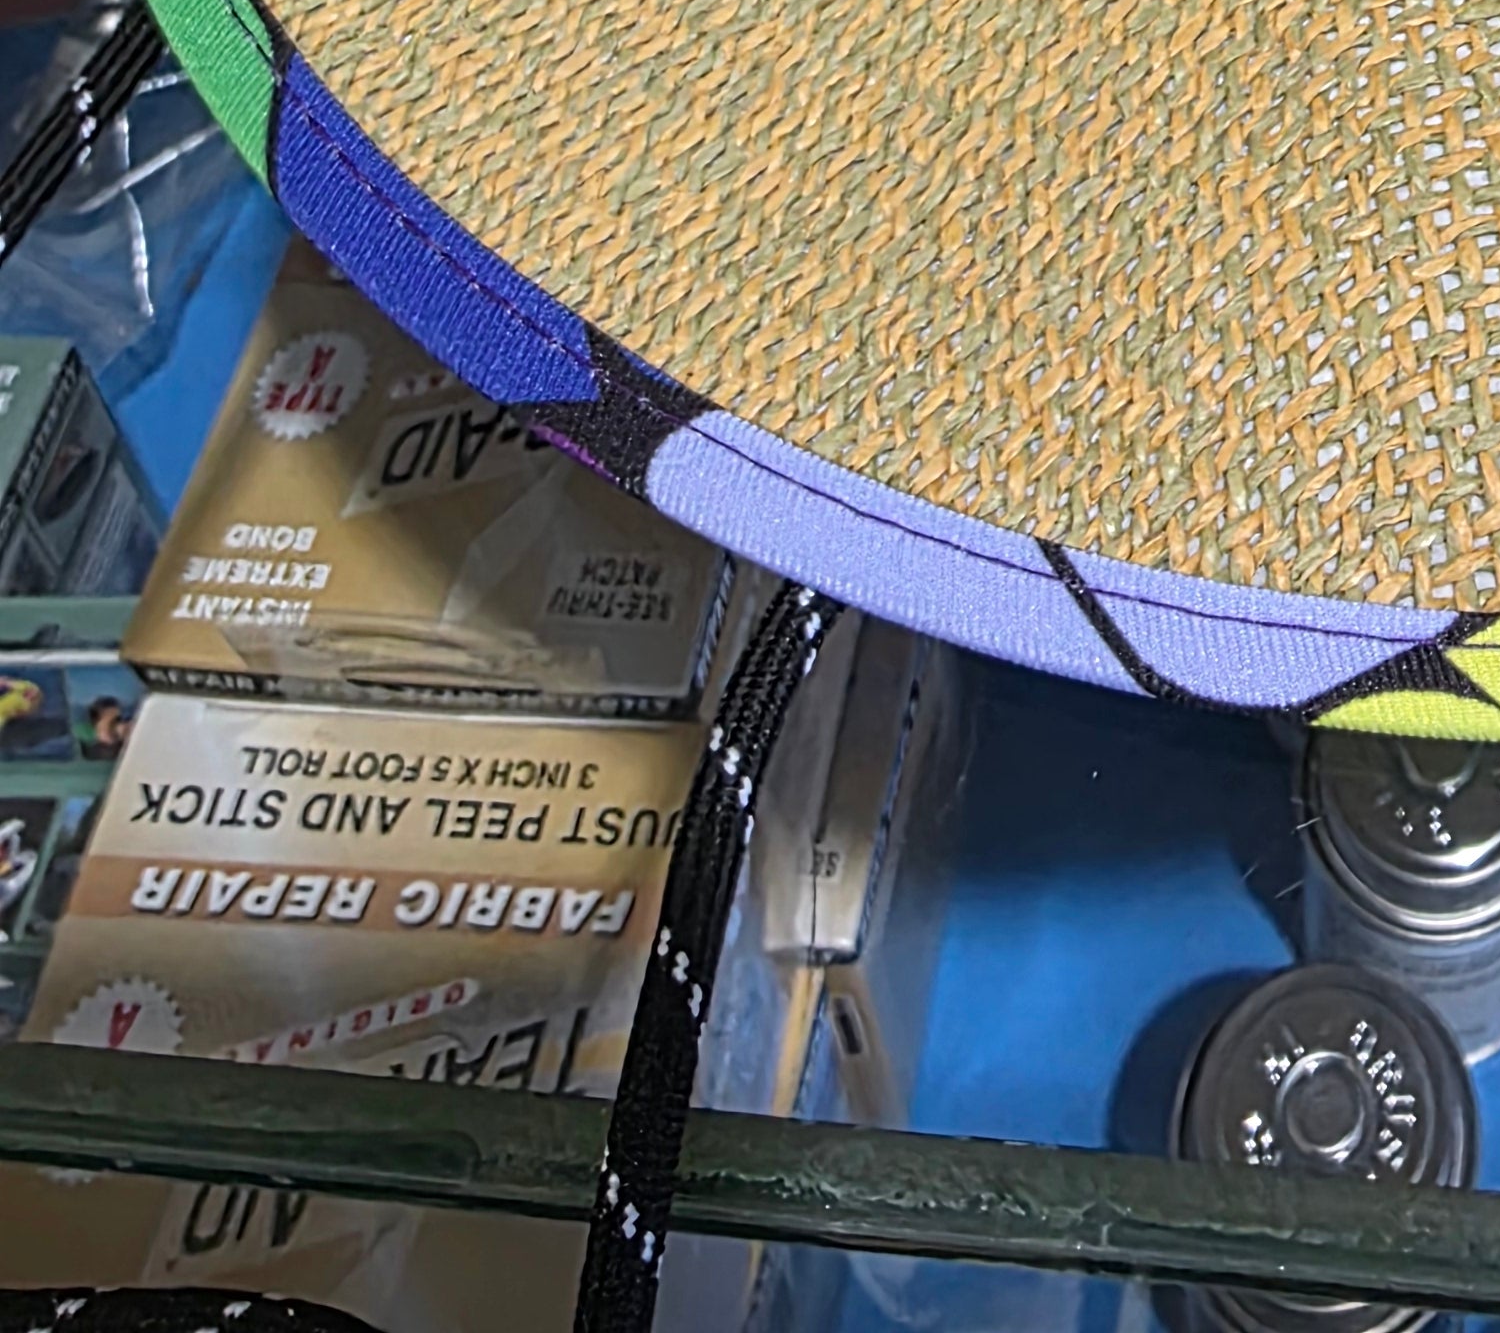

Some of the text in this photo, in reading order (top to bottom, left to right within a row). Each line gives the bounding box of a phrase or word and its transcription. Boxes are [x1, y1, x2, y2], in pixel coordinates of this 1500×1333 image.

[307, 345, 338, 379] A
[265, 382, 344, 414] TYPE
[224, 522, 317, 552] BOND
[182, 555, 331, 590] EXTREME
[577, 555, 664, 583] PATCH
[171, 592, 313, 625] INSTANT
[546, 582, 673, 622] SEE-THRU
[241, 746, 600, 790] 3 INCH X 5 FOOT ROLL
[130, 782, 685, 849] JUST PEEL AND STICK
[130, 865, 637, 934] FABRIC REPAIR
[107, 1001, 142, 1049] A
[226, 980, 468, 1063] ORIGINA
